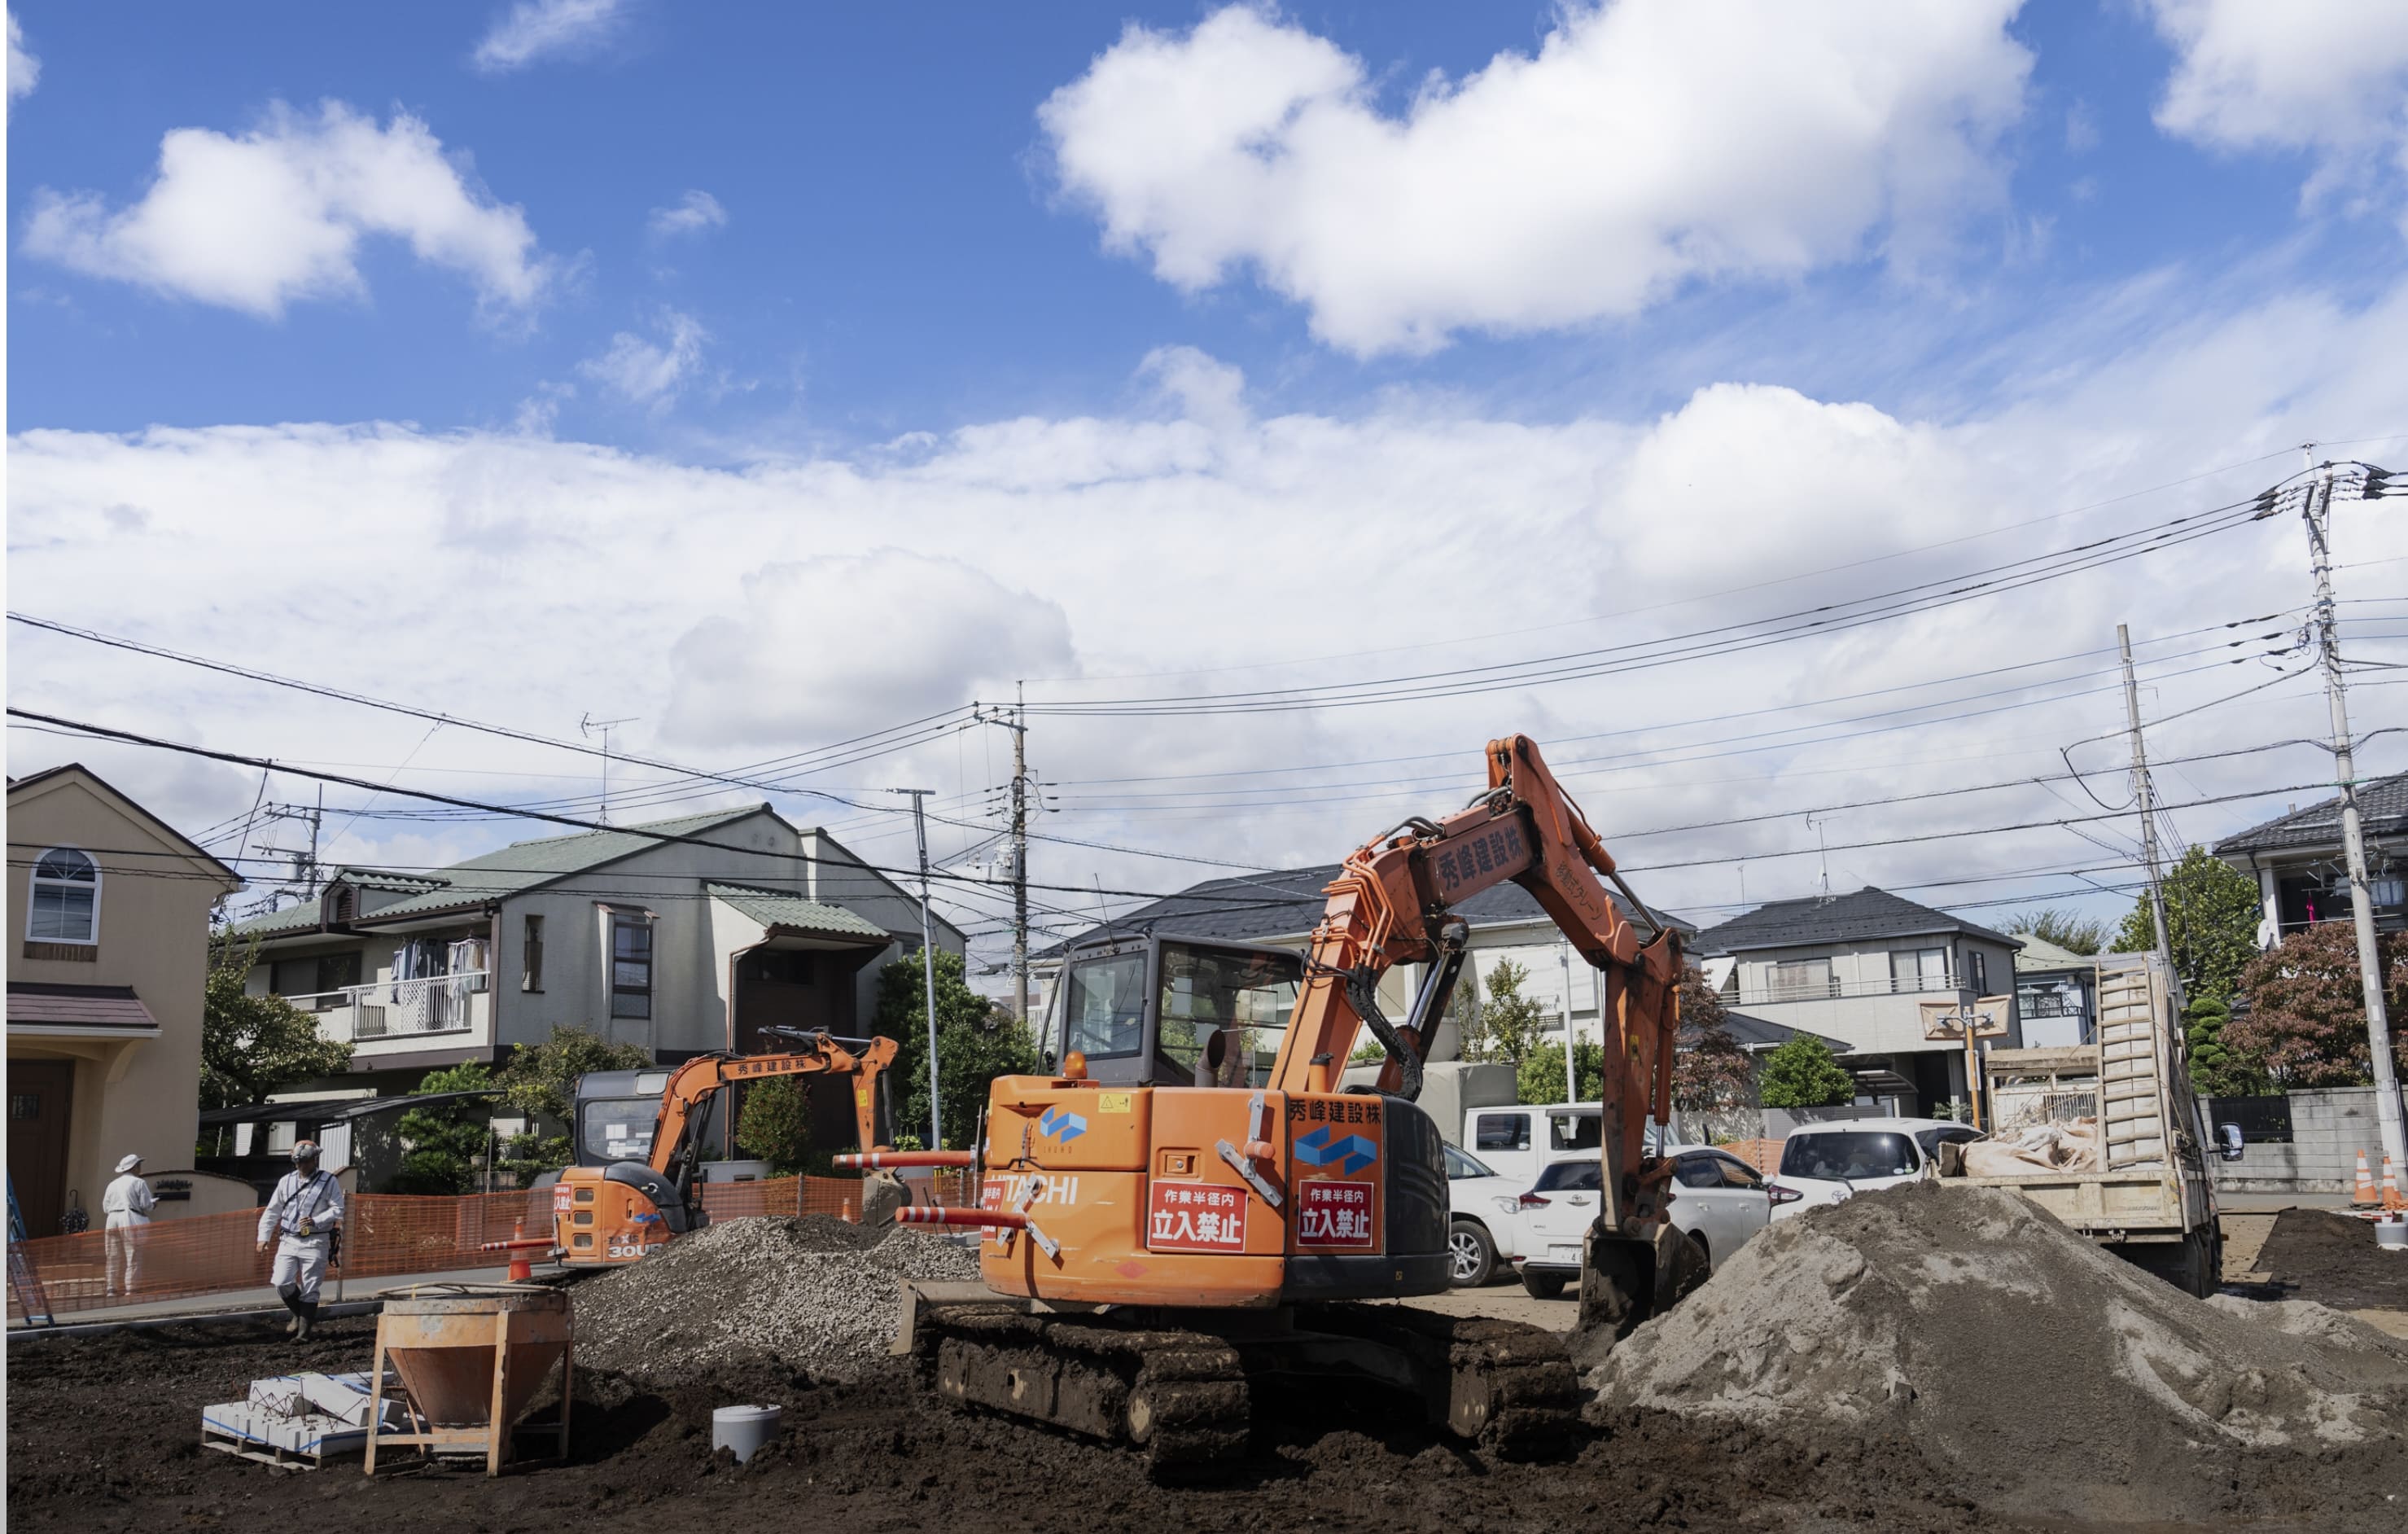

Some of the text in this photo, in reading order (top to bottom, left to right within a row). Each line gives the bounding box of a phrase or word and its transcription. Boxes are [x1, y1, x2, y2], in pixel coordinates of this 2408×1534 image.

[1164, 1189, 1235, 1207] 作業半径内
[1310, 1188, 1364, 1204] 作業半径内
[1152, 1209, 1242, 1244] 立入禁止
[1301, 1207, 1370, 1239] 立入禁止
